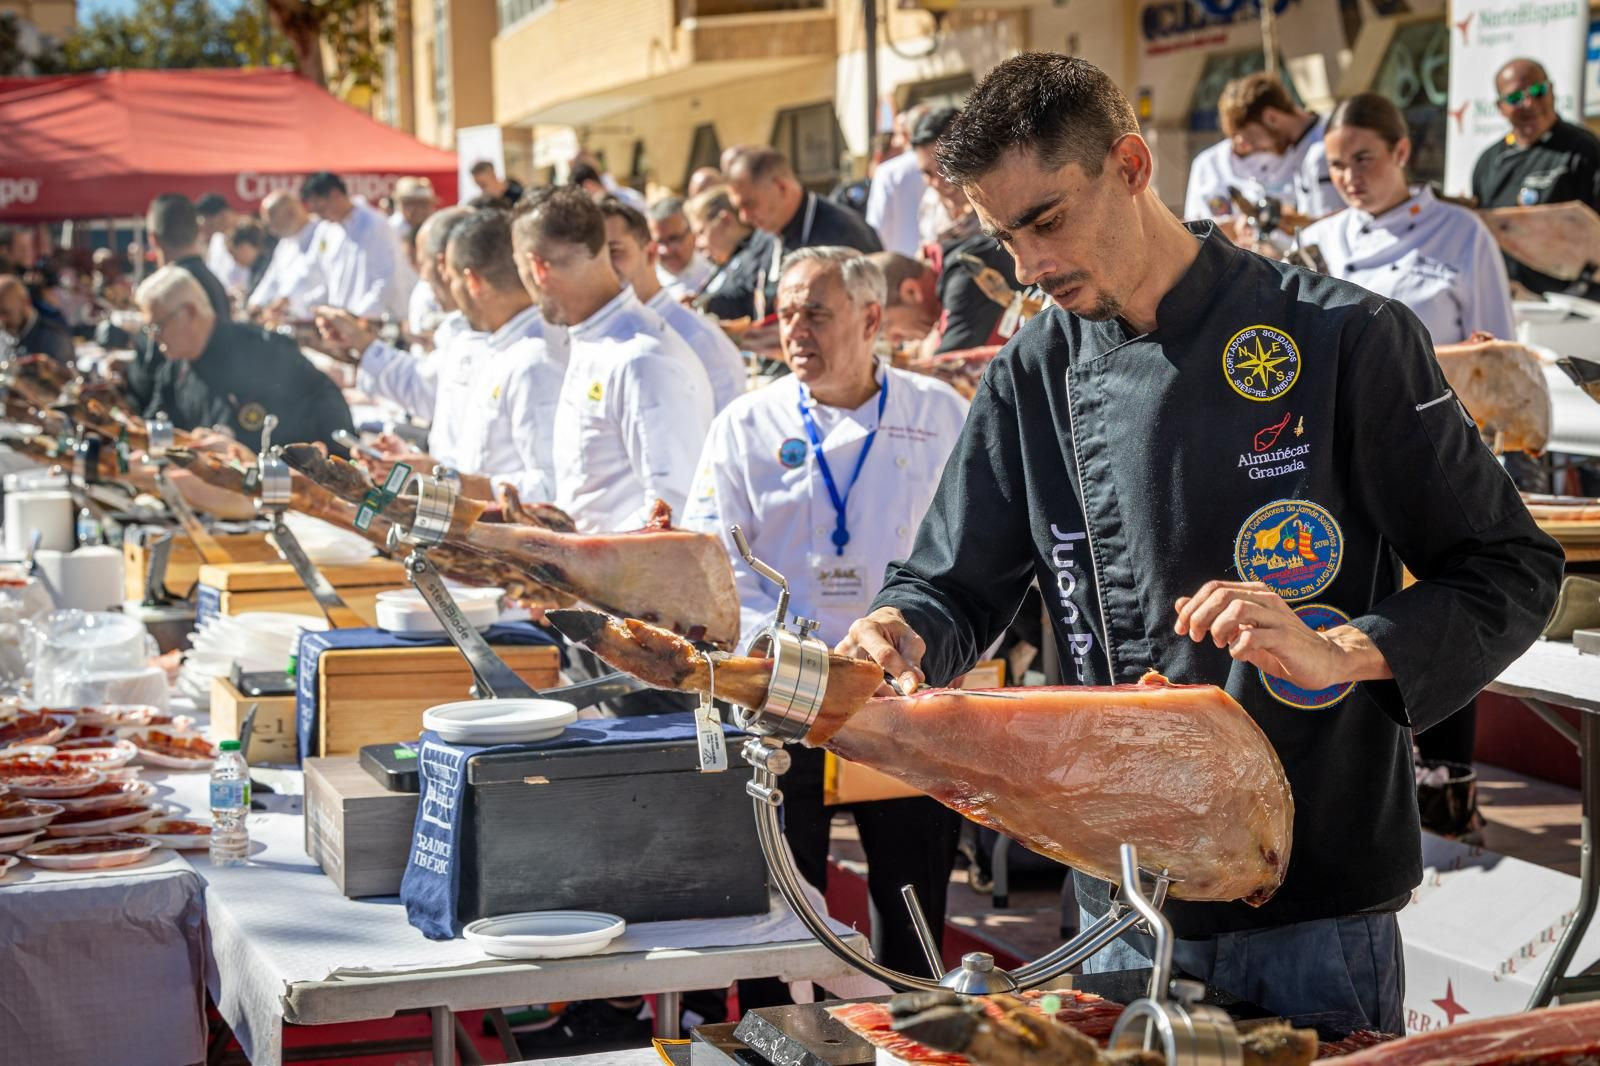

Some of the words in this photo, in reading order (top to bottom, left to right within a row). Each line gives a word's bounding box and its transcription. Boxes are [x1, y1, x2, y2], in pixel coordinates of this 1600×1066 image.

[1226, 330, 1257, 375] CORTADORES
[1262, 329, 1297, 363] SOLIDARIOS
[1238, 345, 1249, 357] N
[1271, 342, 1281, 352] E
[1271, 370, 1295, 395] UNIDOS
[1237, 443, 1311, 468] Almuñécar
[1248, 459, 1306, 480] Granada
[1248, 506, 1285, 531] Cortadores
[1050, 523, 1087, 625] Juan
[1277, 587, 1299, 598] NIÑO
[1300, 583, 1316, 595] SIN
